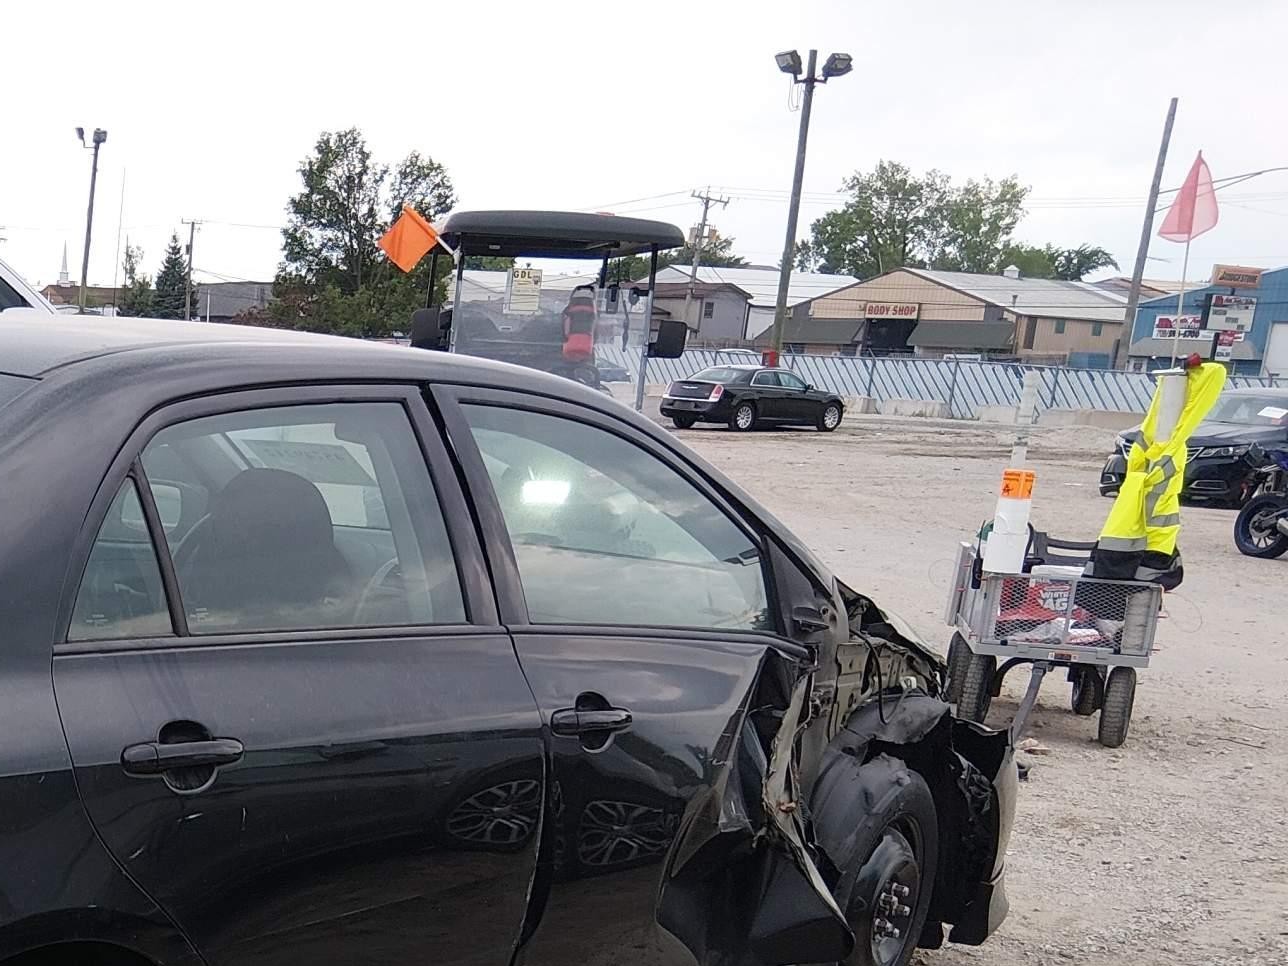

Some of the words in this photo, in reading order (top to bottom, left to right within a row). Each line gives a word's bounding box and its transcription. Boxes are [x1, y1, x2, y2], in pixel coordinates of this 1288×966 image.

[513, 270, 532, 279] GDL
[867, 304, 890, 315] BODY
[892, 304, 916, 316] SHOP
